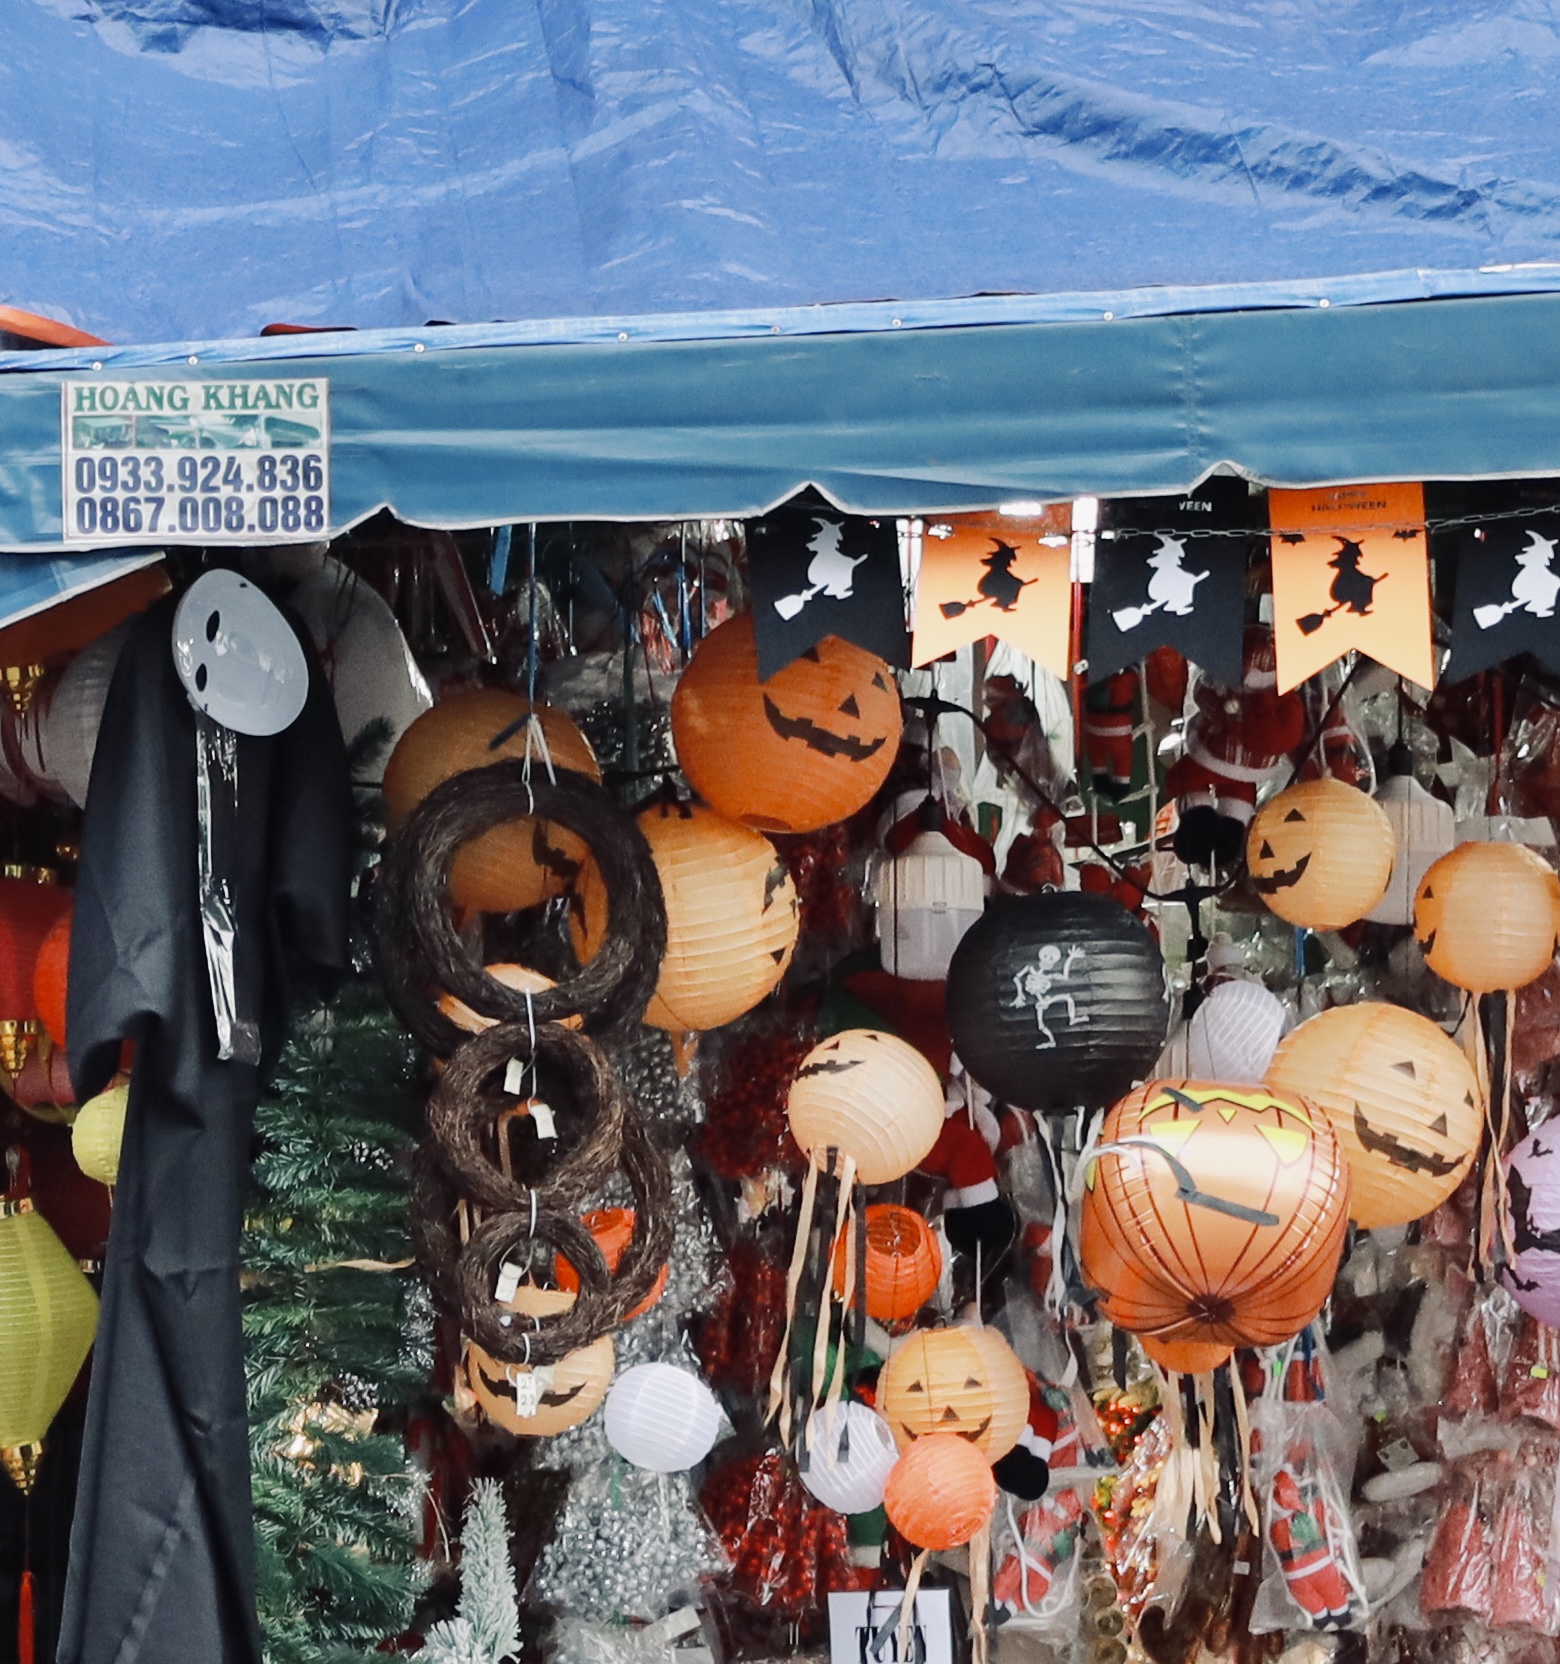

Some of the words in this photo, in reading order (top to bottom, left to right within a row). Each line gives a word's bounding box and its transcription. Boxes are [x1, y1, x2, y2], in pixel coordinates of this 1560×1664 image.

[201, 383, 321, 411] KHANG
[75, 454, 324, 494] 0933.924.836
[76, 495, 325, 534] 0867.008.088
